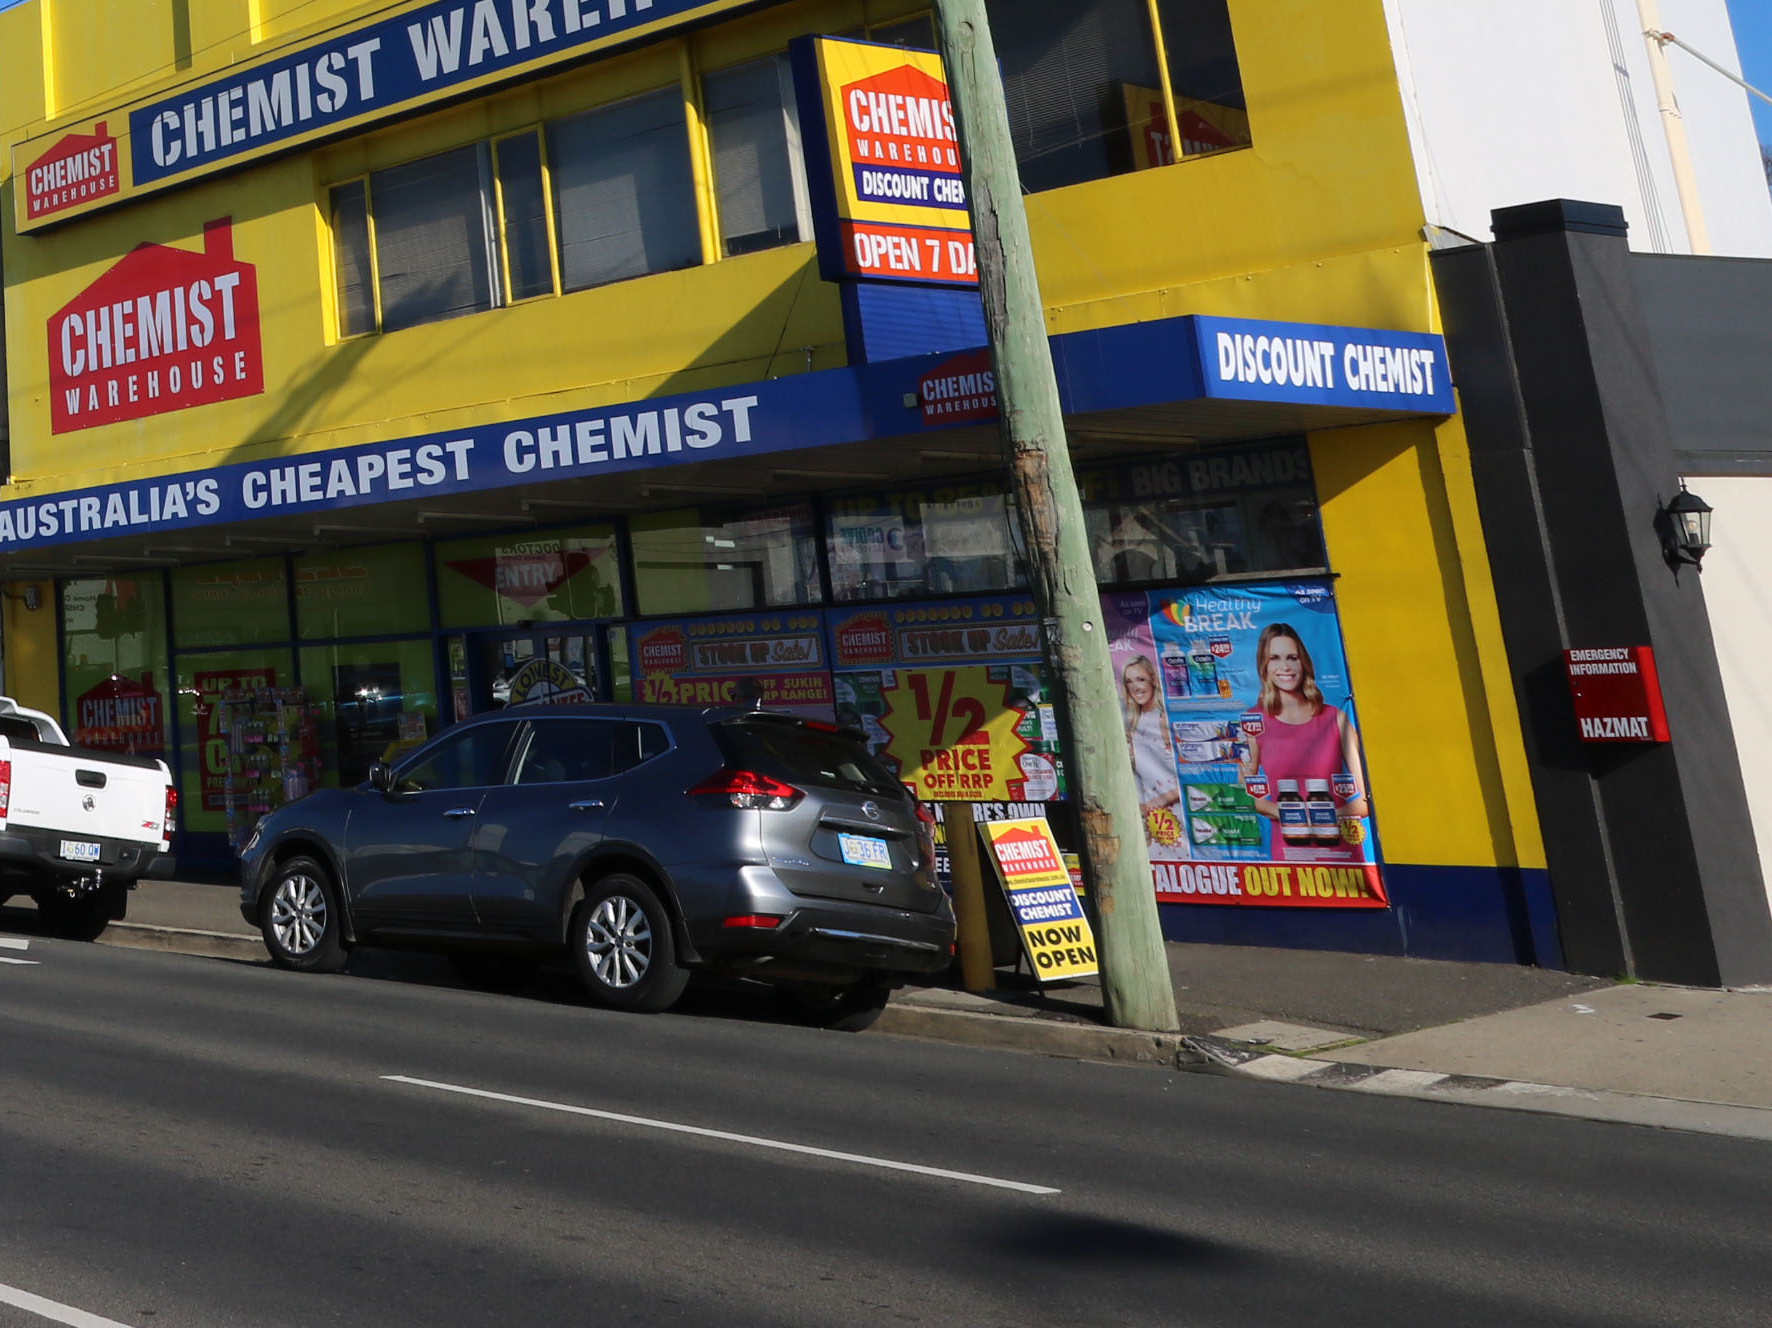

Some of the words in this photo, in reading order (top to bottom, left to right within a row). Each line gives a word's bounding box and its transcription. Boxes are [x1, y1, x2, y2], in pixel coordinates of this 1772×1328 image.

[151, 38, 381, 168] CHEMIST
[849, 89, 958, 142] CHEMIS
[856, 138, 957, 166] WAREHOU
[31, 144, 112, 196] CHEMIST
[33, 175, 115, 212] WAREHOUSE
[862, 171, 929, 201] DISCOUNT
[853, 233, 921, 271] OPEN
[926, 239, 940, 273] 7
[61, 271, 241, 377] CHEMIST
[1216, 333, 1336, 389] DISCOUNT
[1344, 343, 1435, 396] CHEMIST
[66, 351, 246, 416] WAREHOUSE
[923, 371, 995, 401] CHEMIS
[925, 396, 996, 415] WAREHOUS
[242, 439, 475, 510] CHEAPEST
[504, 395, 758, 474] CHEMIST
[1131, 462, 1181, 497] BIG
[496, 562, 557, 589] ENTRY
[1196, 597, 1261, 614] Healthy
[1184, 612, 1258, 633] BREAK
[643, 645, 682, 657] CHEMIST
[842, 632, 886, 647] CHEMIST
[1569, 648, 1629, 661] EMERGENCY
[1569, 662, 1638, 675] INFORMATION
[201, 677, 233, 692] UP
[236, 676, 267, 690] TO
[679, 680, 742, 704] PRIC
[781, 687, 828, 701] RANGE!
[783, 677, 822, 689] SUKIN
[82, 697, 157, 727] CHEMIST
[908, 671, 991, 746] 1/2
[1580, 717, 1648, 738] HAZMAT
[920, 748, 992, 771] PRICE
[923, 773, 956, 789] OFF
[958, 773, 994, 789] RRP
[1153, 812, 1174, 830] 1/2
[994, 839, 1051, 863] CHEMIST
[1002, 859, 1057, 873] WAREHOUSE
[1244, 865, 1292, 896] OUT
[1296, 866, 1369, 898] NOW!
[1011, 889, 1072, 907] DISCOUNT
[1020, 903, 1073, 921] CHEMIST
[1028, 926, 1081, 948] NOW
[1036, 946, 1096, 969] OPEN
